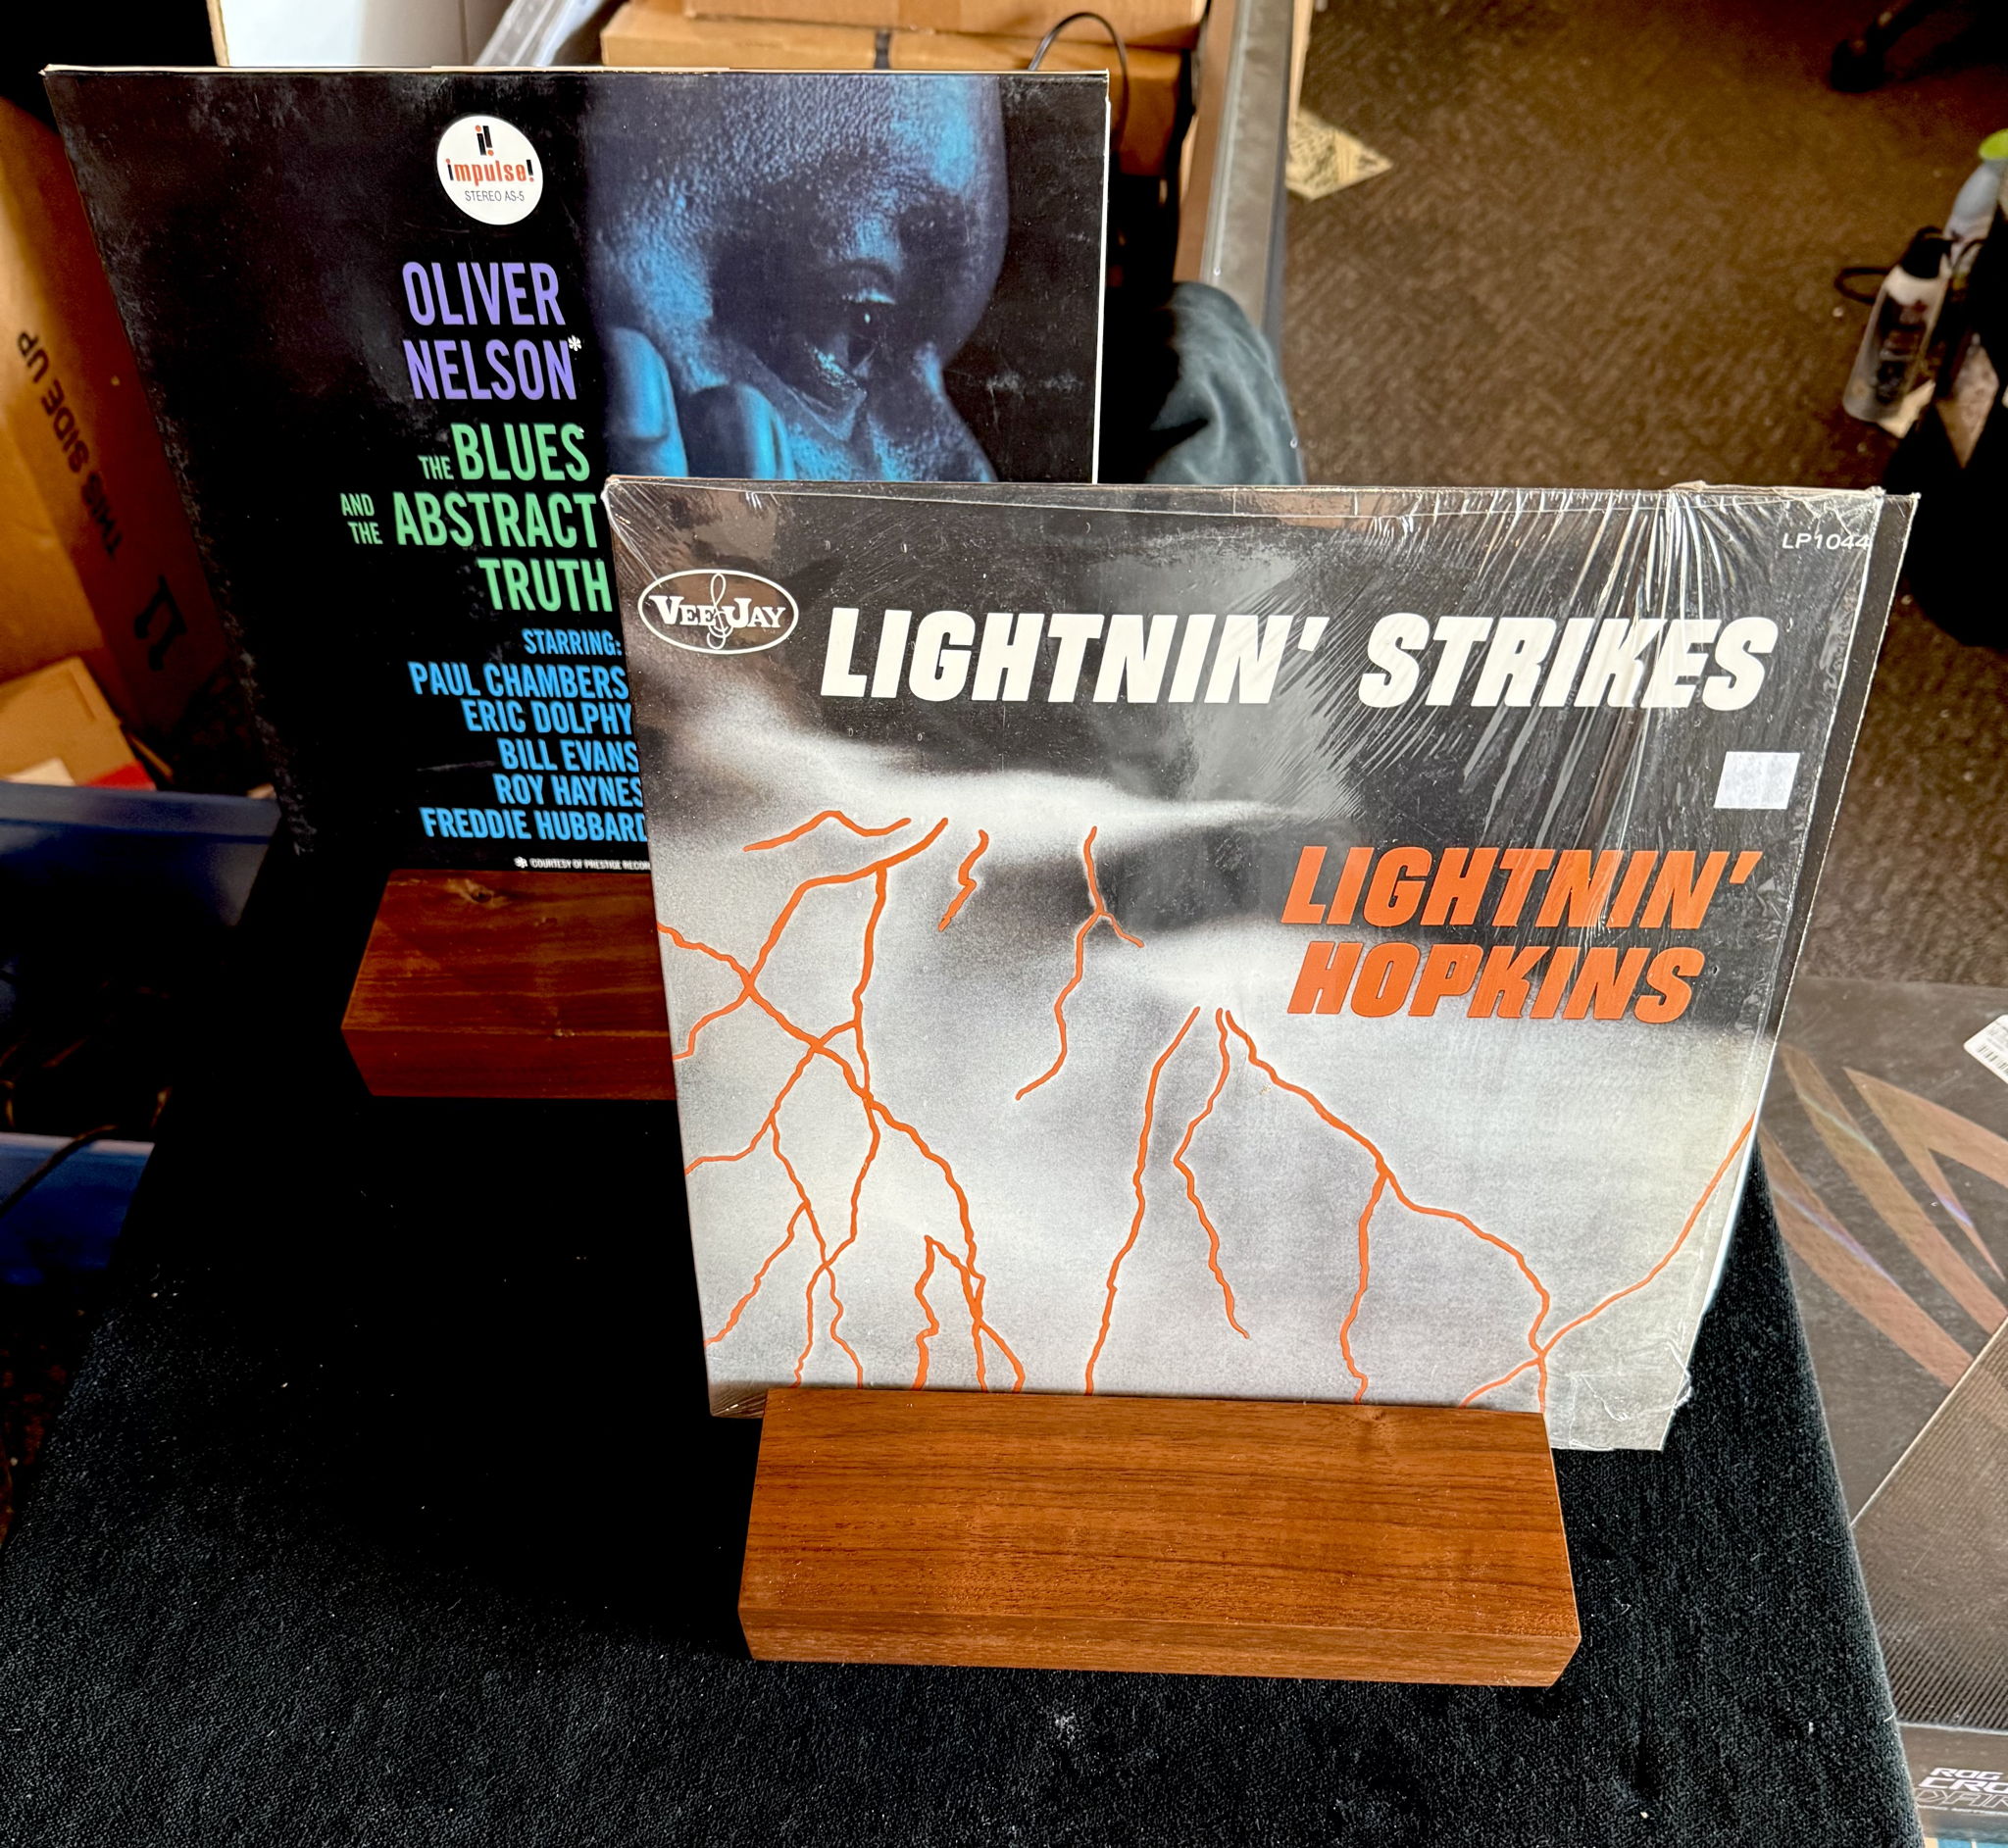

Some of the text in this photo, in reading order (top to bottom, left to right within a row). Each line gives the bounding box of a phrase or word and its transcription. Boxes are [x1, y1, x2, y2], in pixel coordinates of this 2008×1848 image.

[445, 158, 534, 186] impulse!
[465, 190, 526, 202] STEREO AS-5
[402, 262, 565, 325] OLIVER
[17, 331, 50, 384] UP
[41, 379, 90, 474] SIDE
[419, 423, 590, 481] THE BLUES
[340, 493, 375, 517] AND
[348, 491, 598, 548] THE ABSTRACT
[1782, 532, 1872, 550] LP1044
[477, 557, 613, 613] TRUTH
[522, 628, 623, 657] STARRING:
[821, 607, 1779, 711] LIGHTNIN' STRIKES
[408, 661, 630, 700] PAUL CHAMBERS
[461, 698, 634, 735] ERIC DOLPHY
[497, 737, 640, 773] BILL EVANS
[492, 774, 644, 809] ROY HAYNES
[419, 807, 532, 841] FREDDIE
[1280, 844, 1763, 930] LIGHTNIN'
[1286, 941, 1705, 1023] HOPKINS
[1930, 1767, 2004, 1780] ROG
